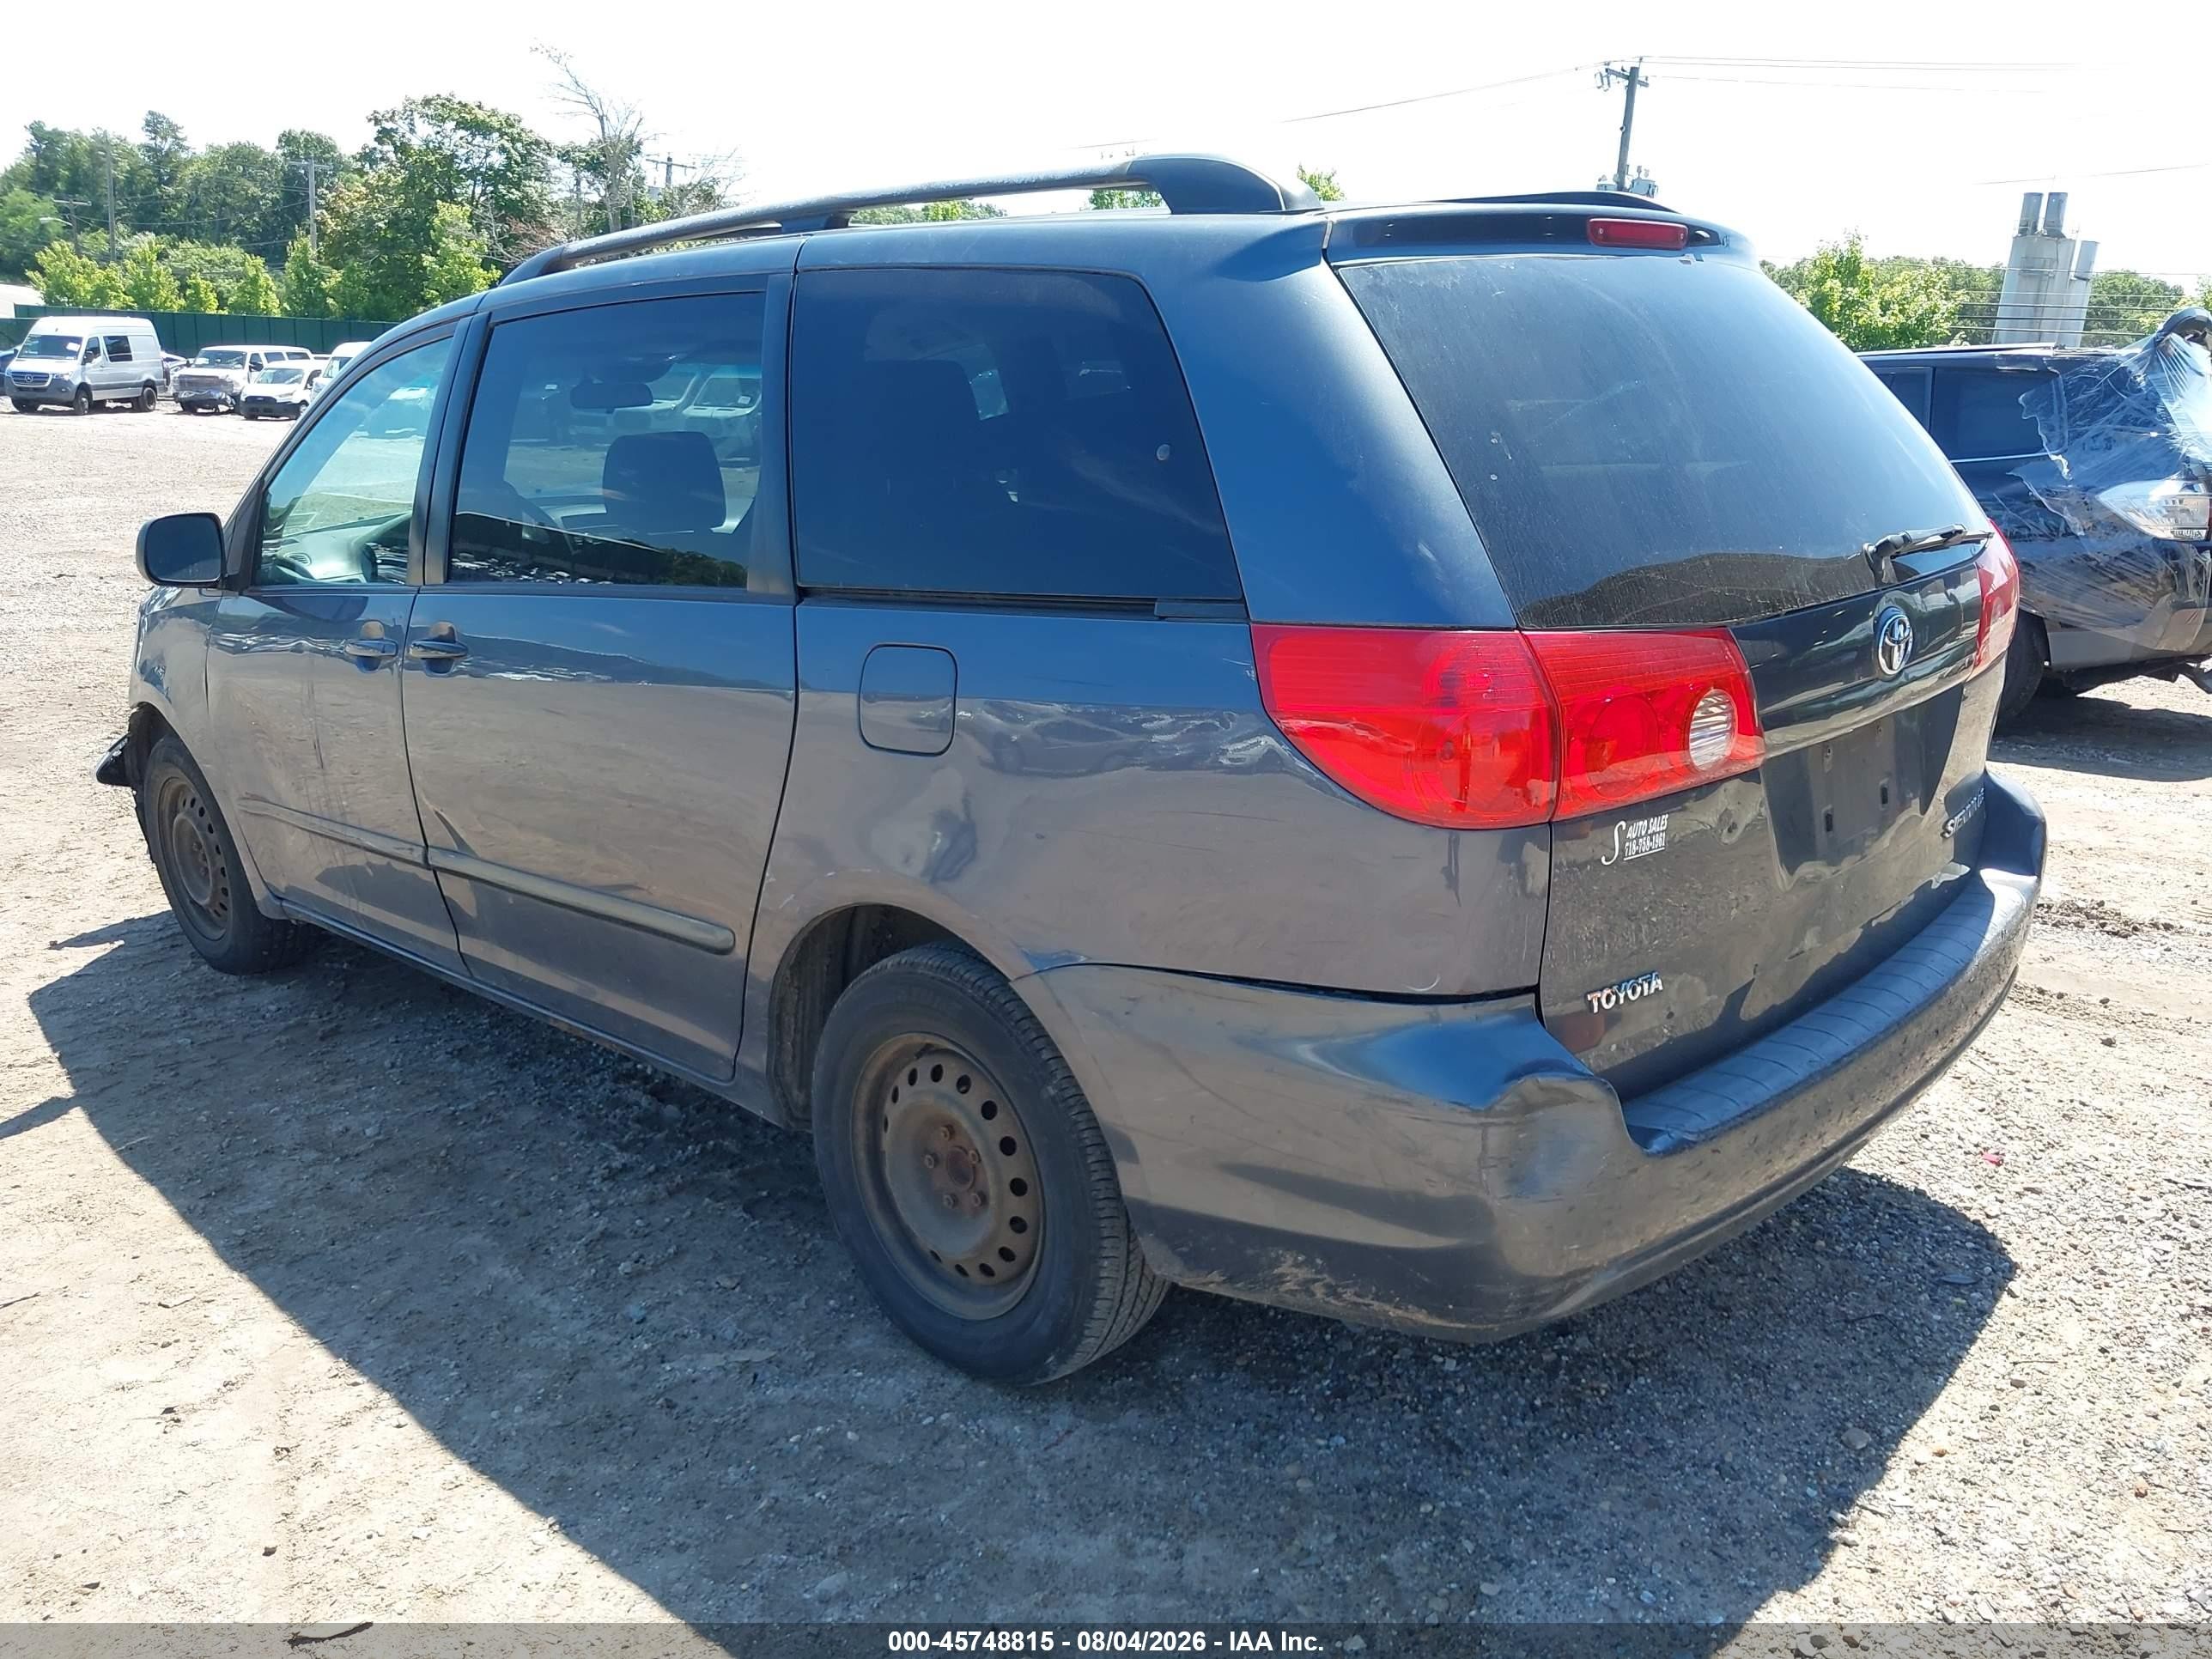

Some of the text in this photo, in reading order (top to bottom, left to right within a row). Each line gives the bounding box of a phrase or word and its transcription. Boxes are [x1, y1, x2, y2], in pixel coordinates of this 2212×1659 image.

[1601, 813, 1669, 866] S AUTO SALES
[1587, 971, 1663, 1014] TOYOTA
